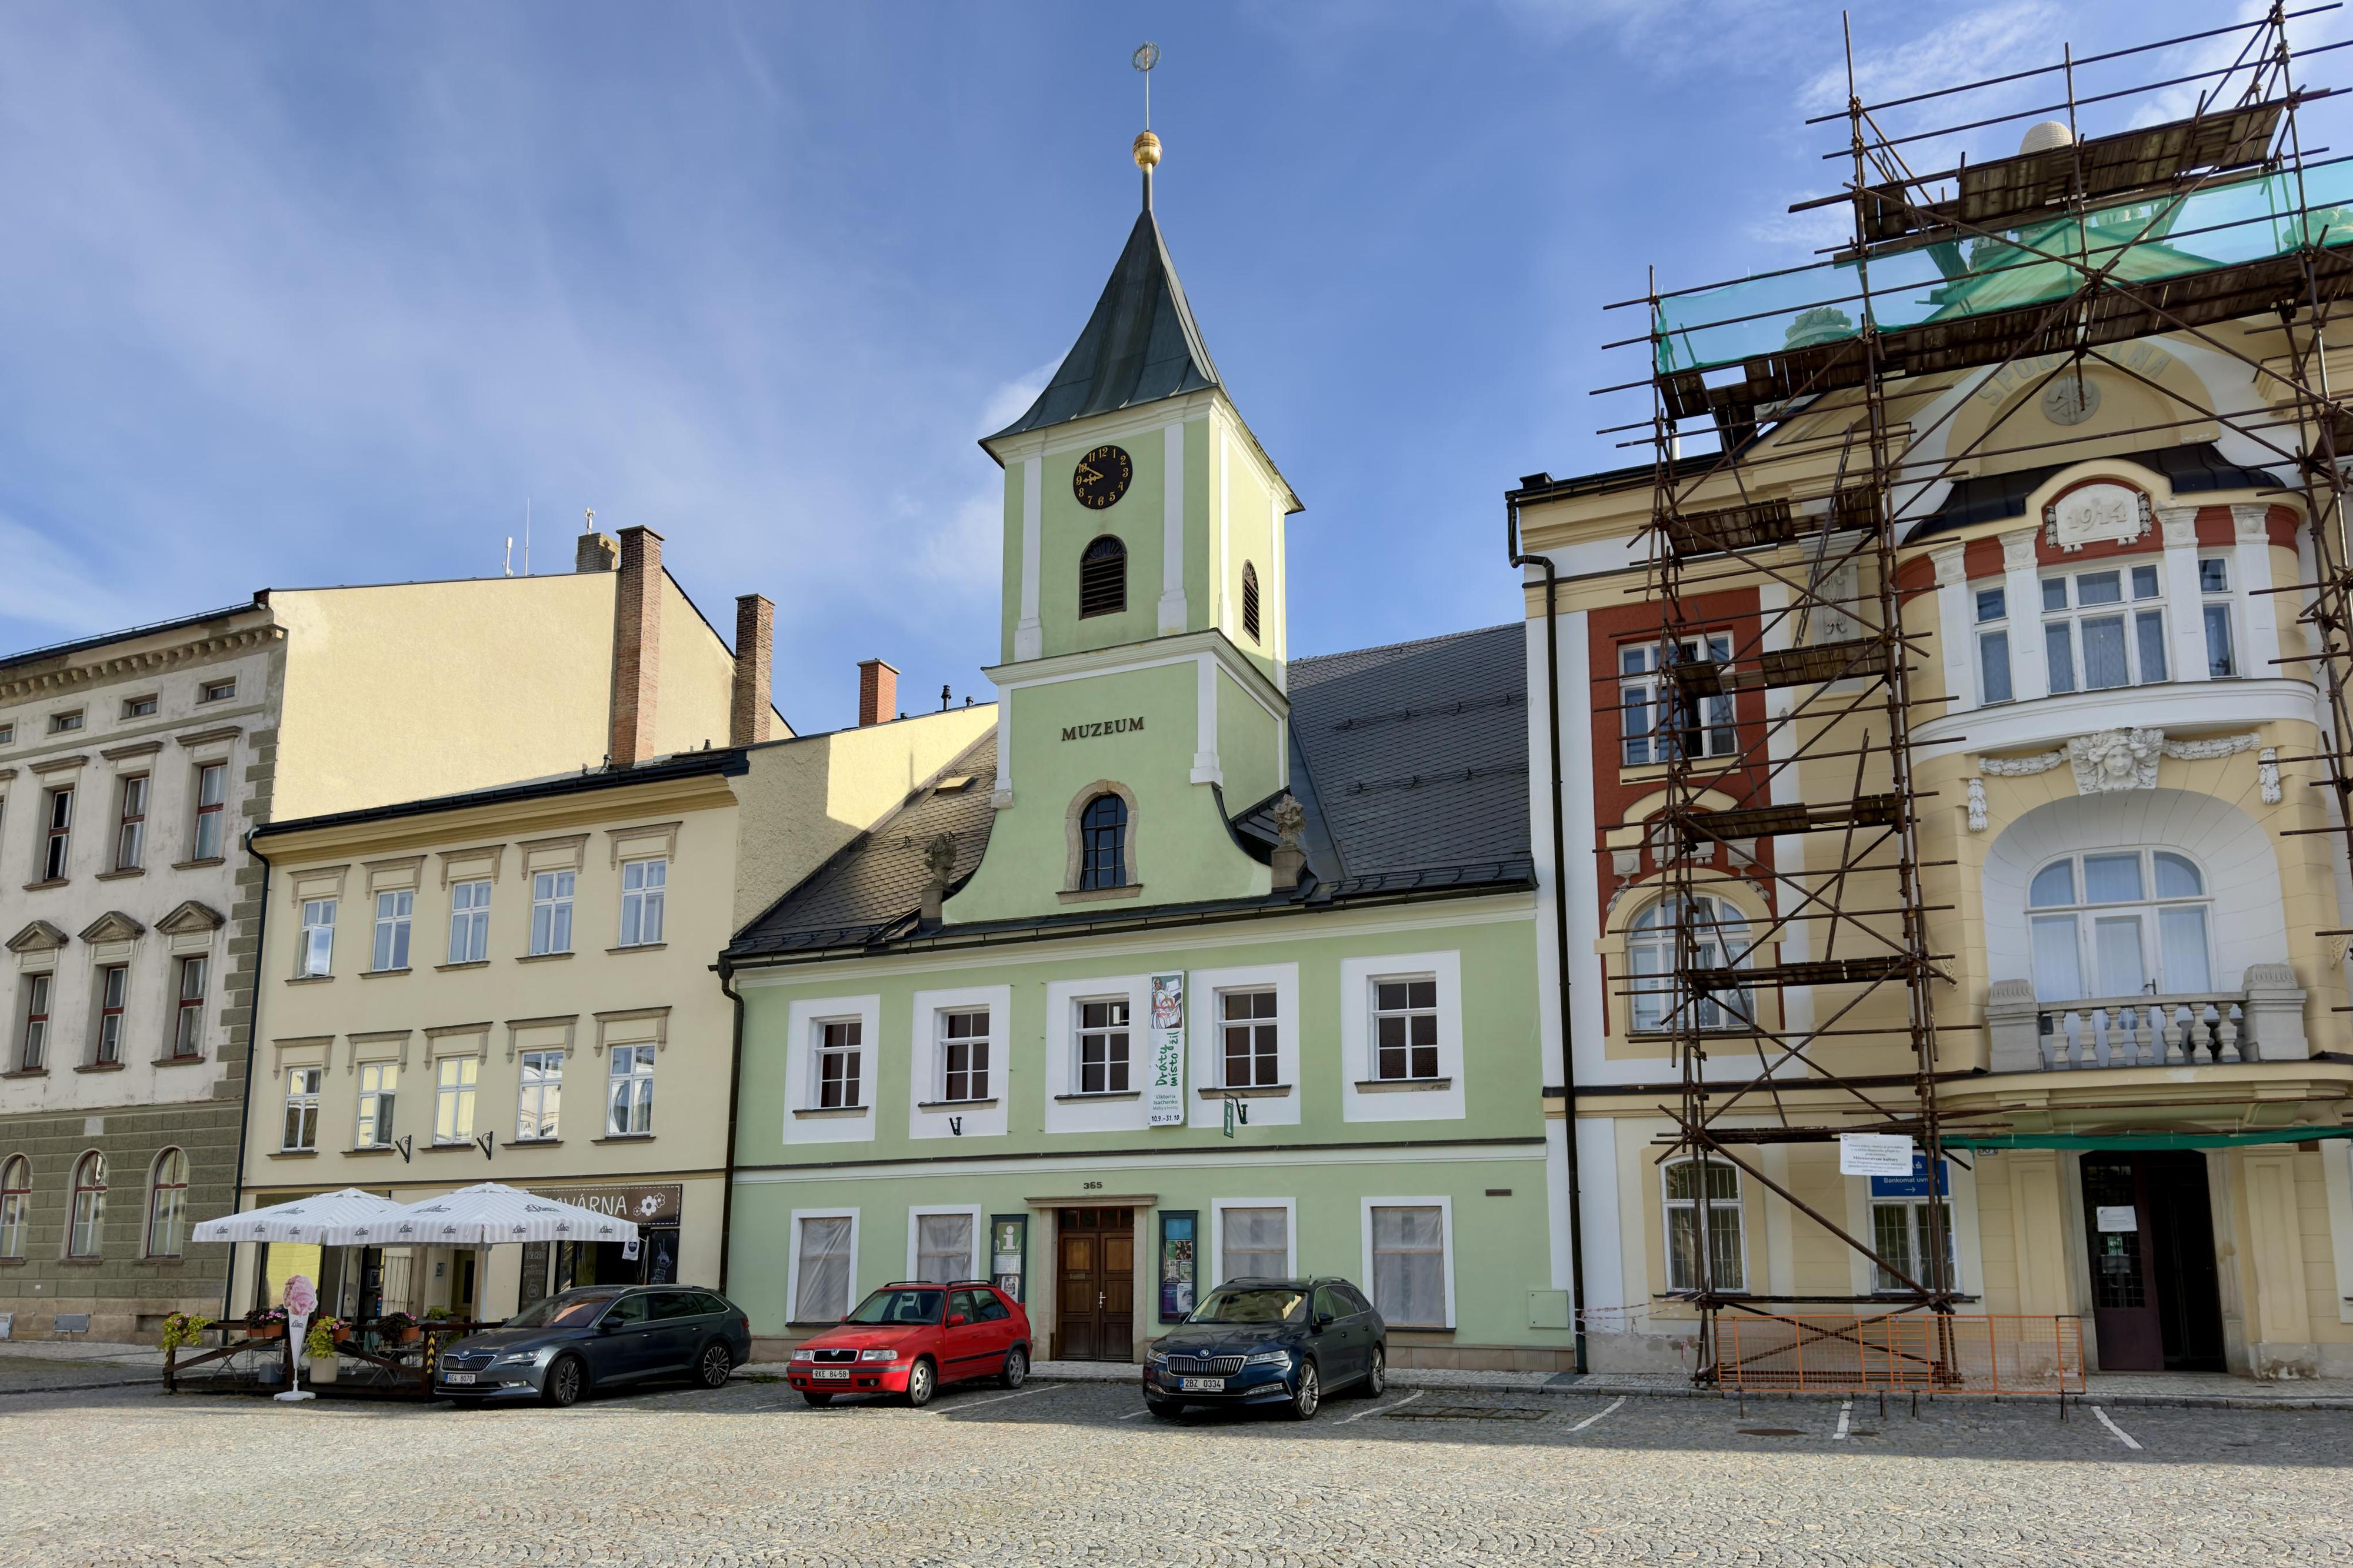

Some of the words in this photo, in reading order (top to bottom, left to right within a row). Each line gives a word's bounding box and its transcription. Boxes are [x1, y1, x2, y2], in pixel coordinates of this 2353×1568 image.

[1978, 340, 2172, 406] SPOLNA
[1089, 452, 1095, 462] 11
[1099, 447, 1108, 458] 12
[1113, 448, 1116, 458] 1
[1121, 455, 1126, 465] 2
[1122, 468, 1128, 478] 3
[1076, 475, 1082, 486] 9
[1118, 481, 1124, 491] 4
[1078, 488, 1084, 498] 8
[1109, 491, 1115, 502] 5
[1088, 495, 1093, 505] 7
[1098, 496, 1104, 506] 6
[2067, 501, 2127, 532] 1914
[1061, 716, 1144, 741] MUZEUM
[1166, 1031, 1179, 1045] žil
[1155, 1044, 1174, 1086] Dráty
[1168, 1053, 1178, 1086] místo
[549, 1193, 627, 1216] ÁRNA
[1185, 1379, 1198, 1387] 2BZ
